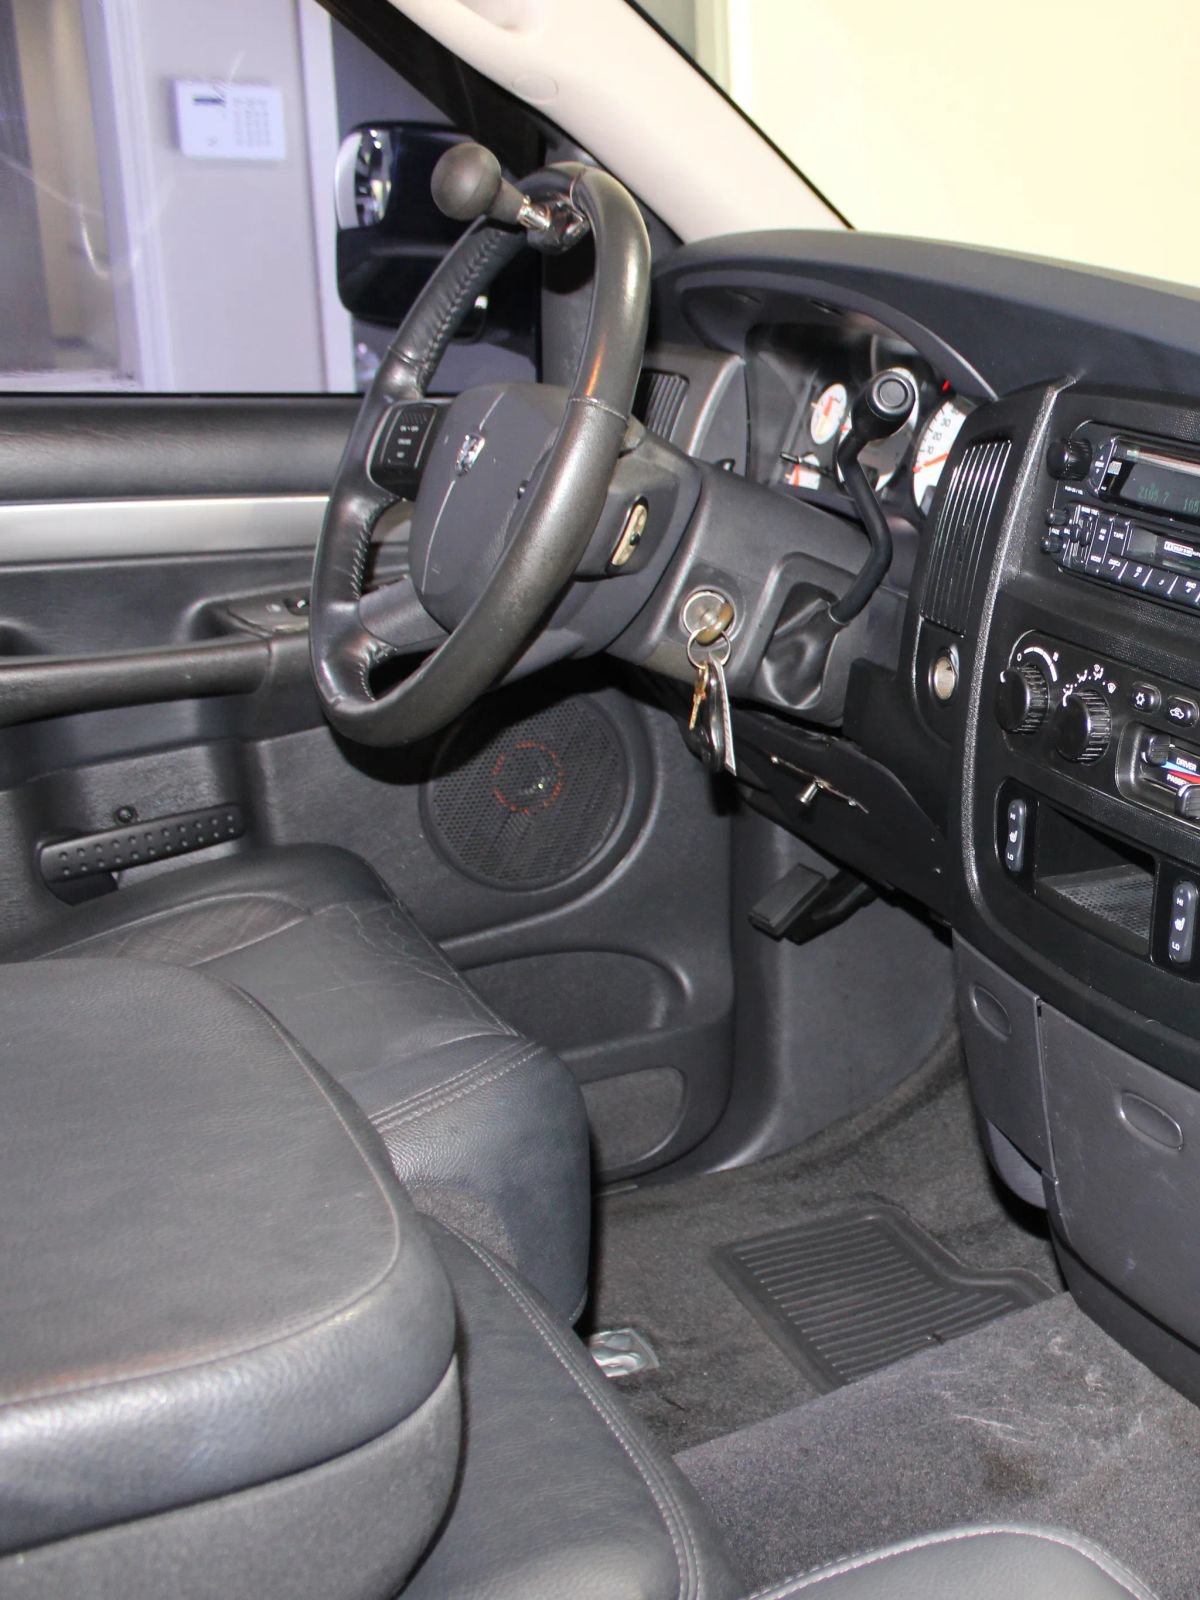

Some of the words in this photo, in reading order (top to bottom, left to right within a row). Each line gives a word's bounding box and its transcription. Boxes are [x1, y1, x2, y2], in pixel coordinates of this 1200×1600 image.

[940, 417, 951, 427] 30
[932, 431, 942, 441] 20
[1176, 757, 1197, 772] DRIVER
[1008, 852, 1014, 861] LO
[1171, 941, 1181, 951] LO
